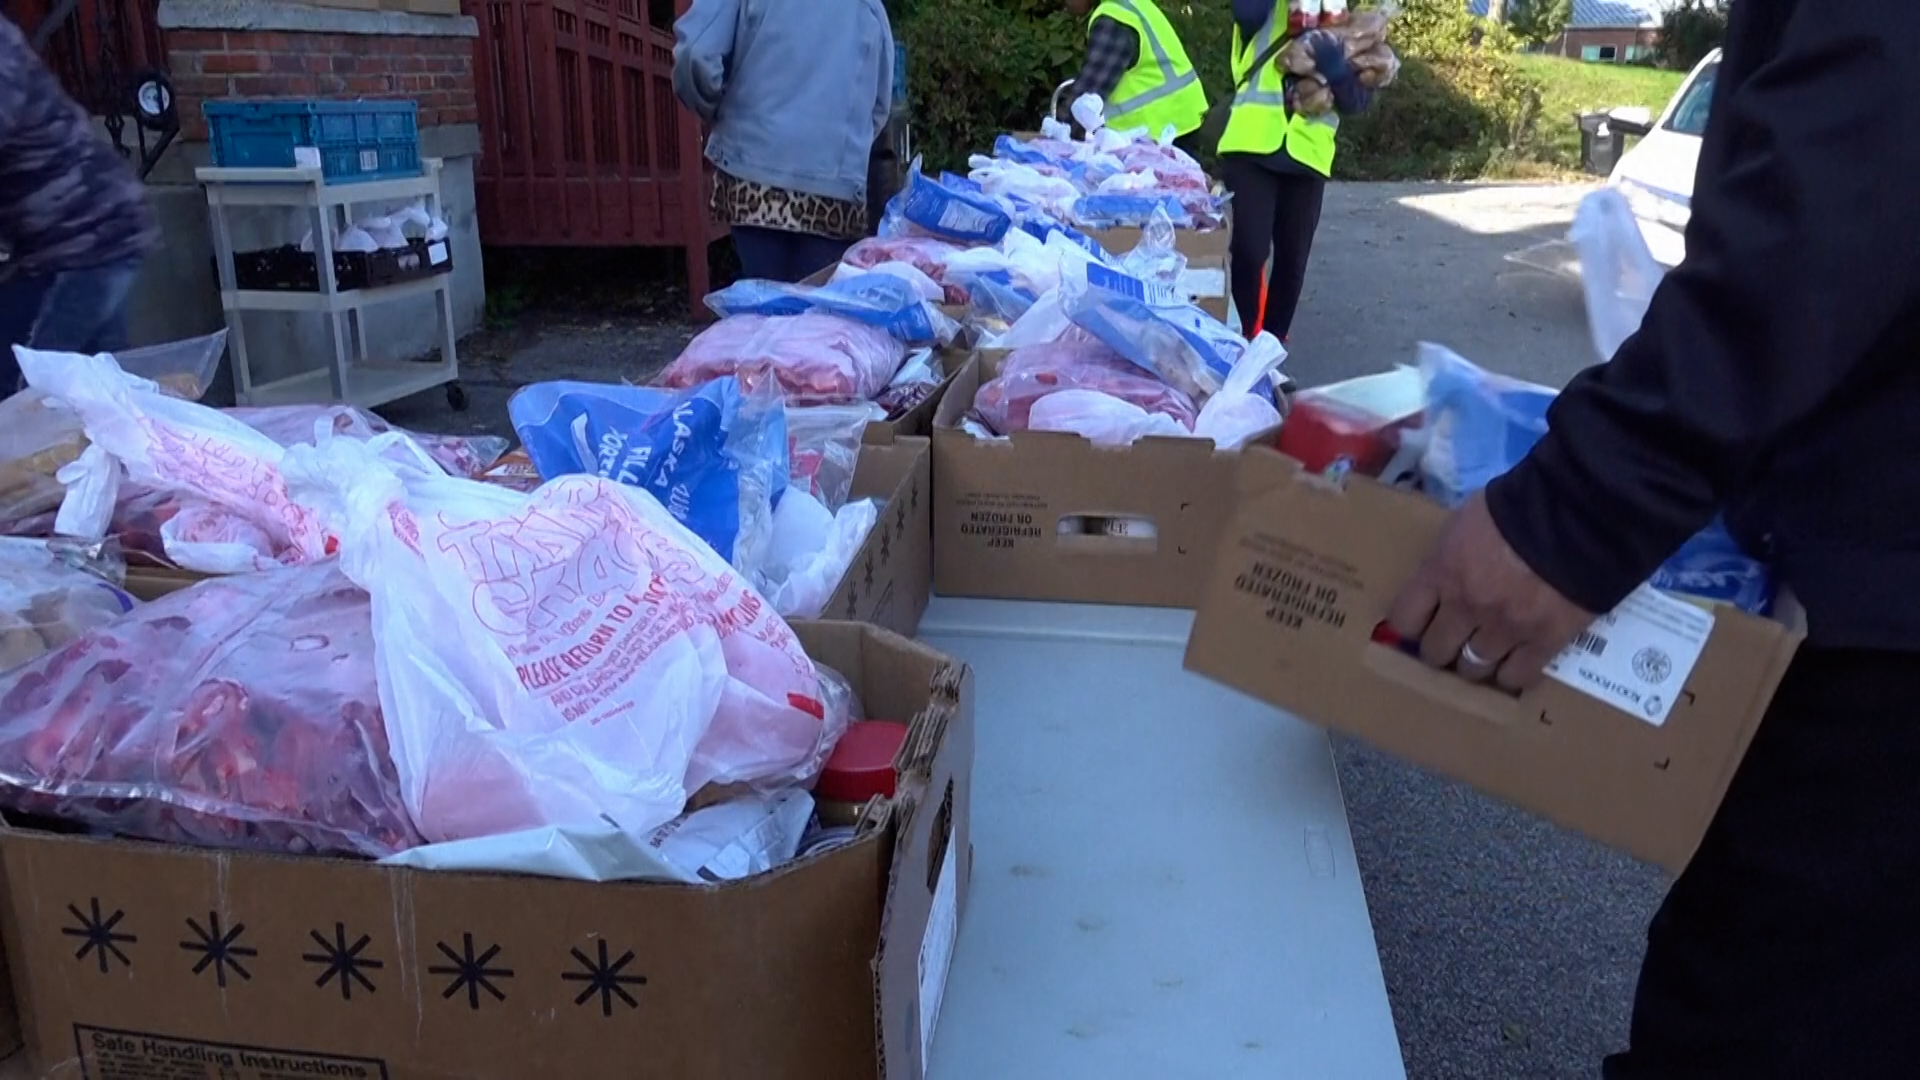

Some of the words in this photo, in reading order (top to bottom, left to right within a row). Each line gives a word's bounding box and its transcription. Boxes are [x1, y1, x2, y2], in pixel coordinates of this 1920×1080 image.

[971, 511, 1013, 523] FROZEN
[1017, 512, 1032, 524] OR
[960, 523, 1041, 538] REFRIGERATED
[987, 537, 1014, 549] KEEP
[516, 655, 570, 692] PLEASE
[560, 623, 617, 671] RETURN
[606, 604, 633, 624] TO
[92, 1032, 136, 1054] Safe
[142, 1040, 233, 1068] Handling
[239, 1051, 369, 1078] Instructions
